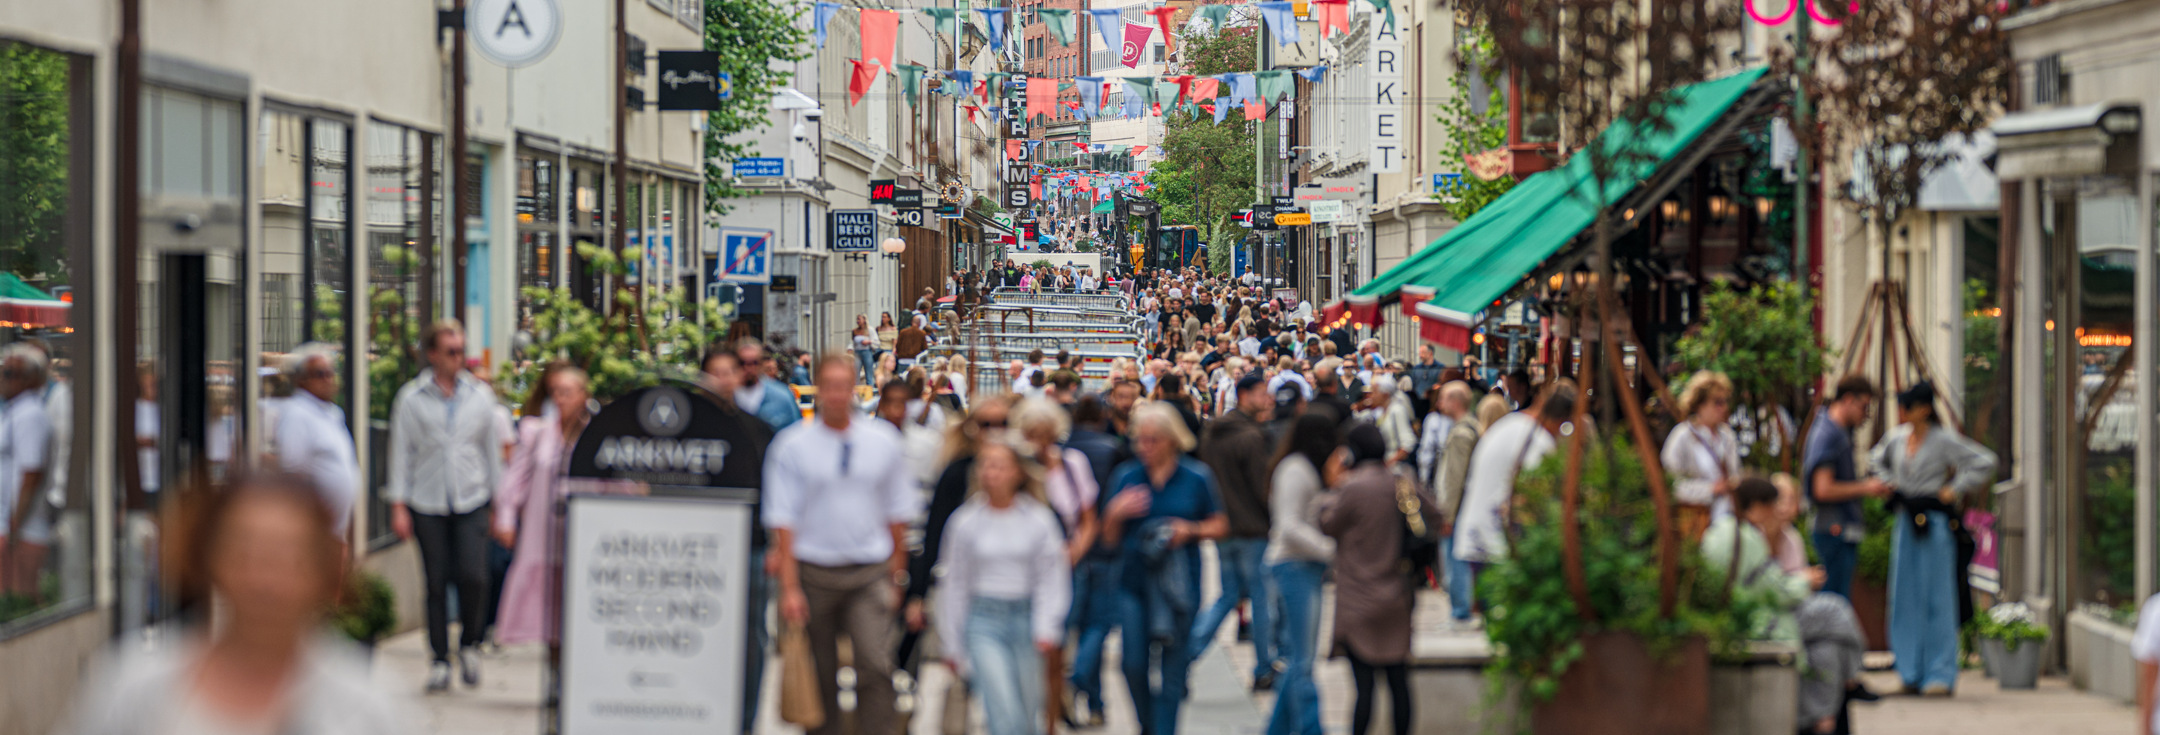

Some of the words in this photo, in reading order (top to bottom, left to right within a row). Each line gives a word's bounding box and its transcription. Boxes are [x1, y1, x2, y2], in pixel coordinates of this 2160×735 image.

[495, 0, 533, 38] A
[1376, 18, 1397, 169] ARKET
[838, 214, 871, 224] HALL
[897, 210, 921, 225] MQ
[1258, 211, 1273, 219] ec
[838, 224, 872, 235] BERG
[838, 236, 872, 247] GULD
